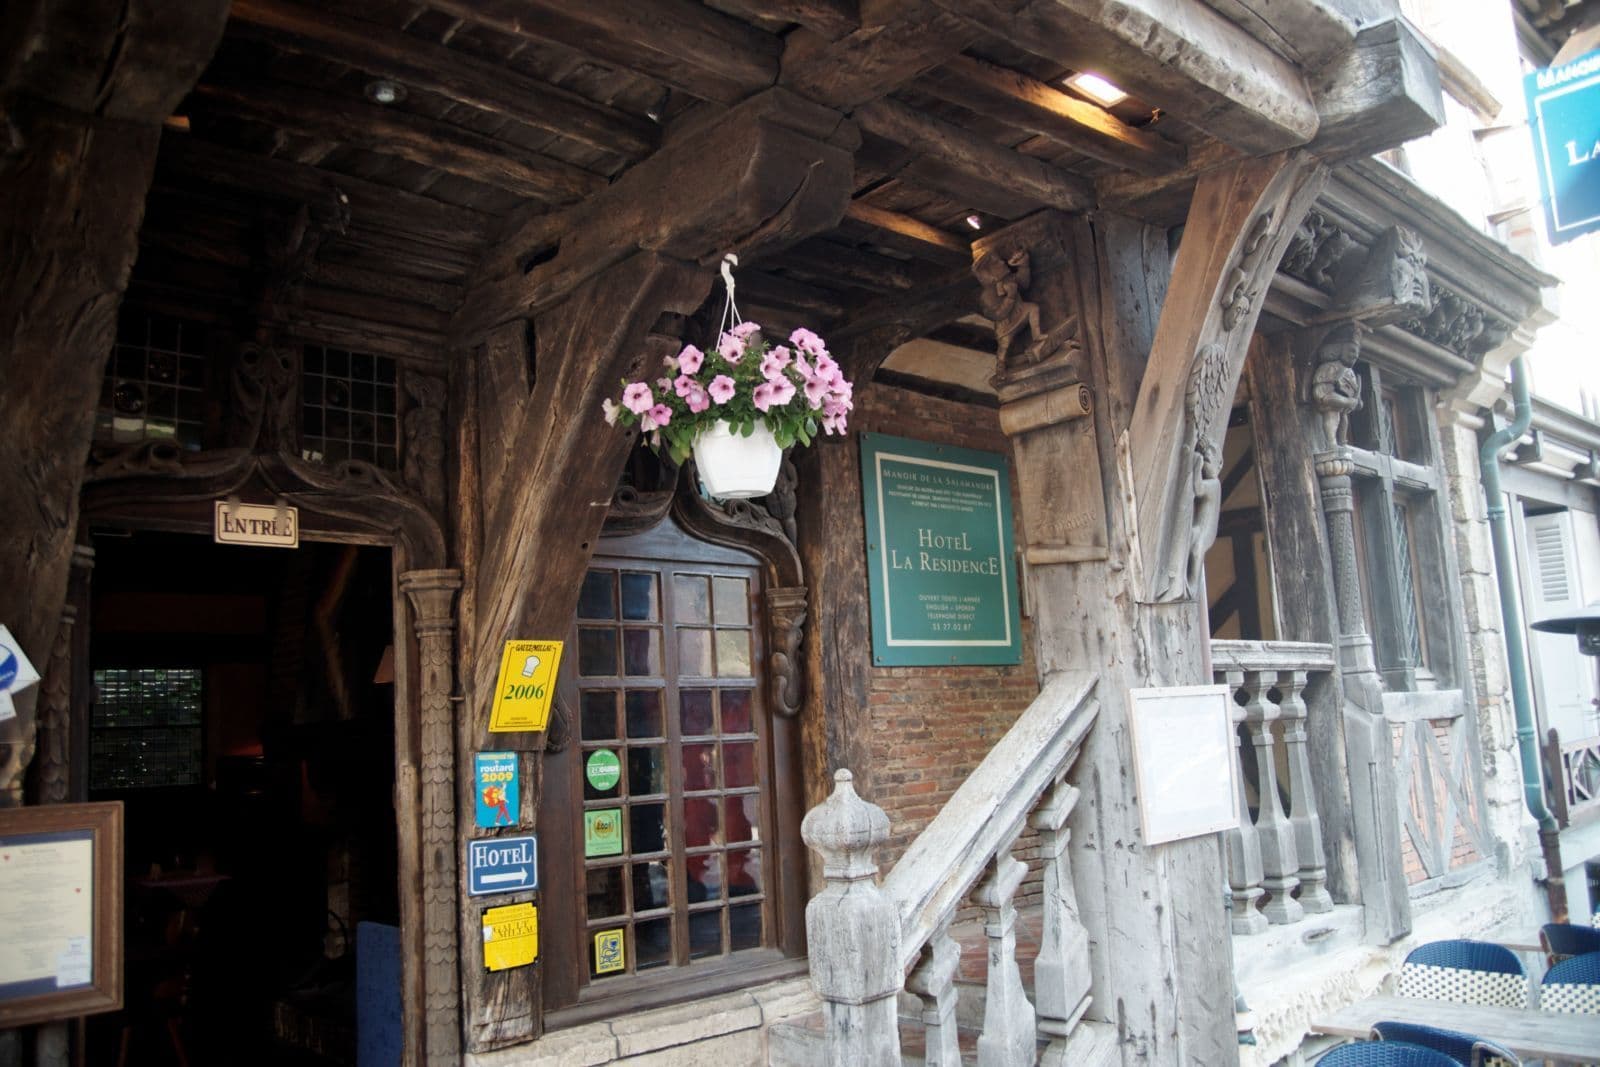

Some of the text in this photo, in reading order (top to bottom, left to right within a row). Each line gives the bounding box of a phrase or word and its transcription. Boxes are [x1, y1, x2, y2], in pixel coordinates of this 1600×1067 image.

[882, 469, 918, 481] MANOIR
[920, 474, 930, 483] DE
[918, 528, 972, 551] HOTEL
[892, 550, 999, 575] LA RESIDENCE
[504, 684, 545, 700] 2006
[480, 763, 514, 773] routard
[474, 843, 532, 868] HOTEL
